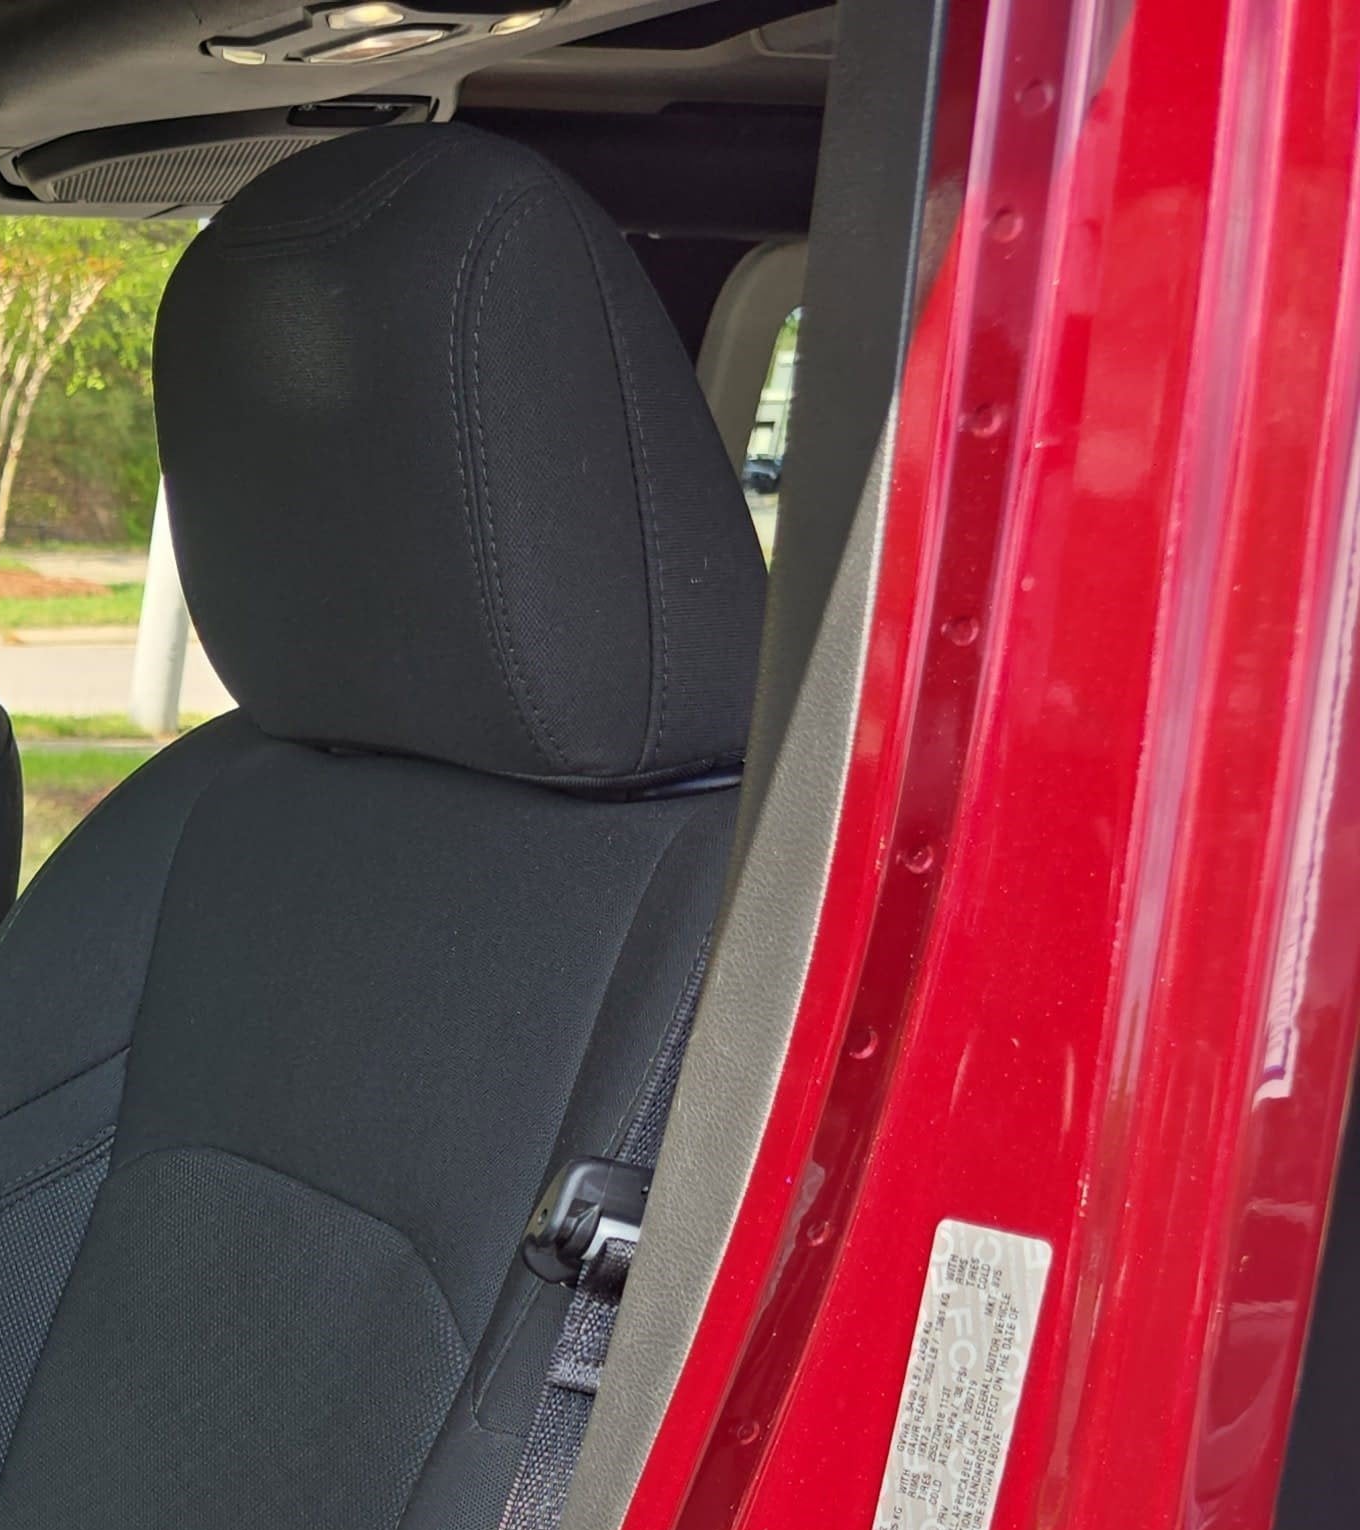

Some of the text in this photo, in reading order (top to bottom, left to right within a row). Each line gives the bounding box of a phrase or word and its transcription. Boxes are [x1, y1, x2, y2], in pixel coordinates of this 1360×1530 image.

[947, 1254, 958, 1280] WITH
[955, 1258, 968, 1283] RIMS
[965, 1257, 979, 1286] TIRES
[977, 1264, 990, 1289] COLD
[1008, 1305, 1019, 1320] OF
[923, 1321, 932, 1334] KG
[1001, 1323, 1015, 1349] DATE
[907, 1424, 920, 1455] GAWR
[940, 1293, 950, 1306] KG
[995, 1353, 1009, 1372] THE
[992, 1376, 1003, 1391] ON
[951, 1457, 972, 1519] APPLICABLE
[973, 1377, 991, 1422] FEDERAL
[984, 1337, 1000, 1373] MOTOR
[993, 1293, 1010, 1334] VEHICLE
[983, 1393, 999, 1431] EFFECT
[980, 1434, 990, 1444] IN
[938, 1452, 947, 1466] AT
[899, 1469, 909, 1494] WITH
[908, 1473, 920, 1498] RIMS
[917, 1472, 932, 1500] TIRES
[966, 1448, 987, 1508] STANDARDS
[977, 1469, 994, 1506] SHOWN
[928, 1478, 942, 1505] COLD
[892, 1506, 902, 1519] KG
